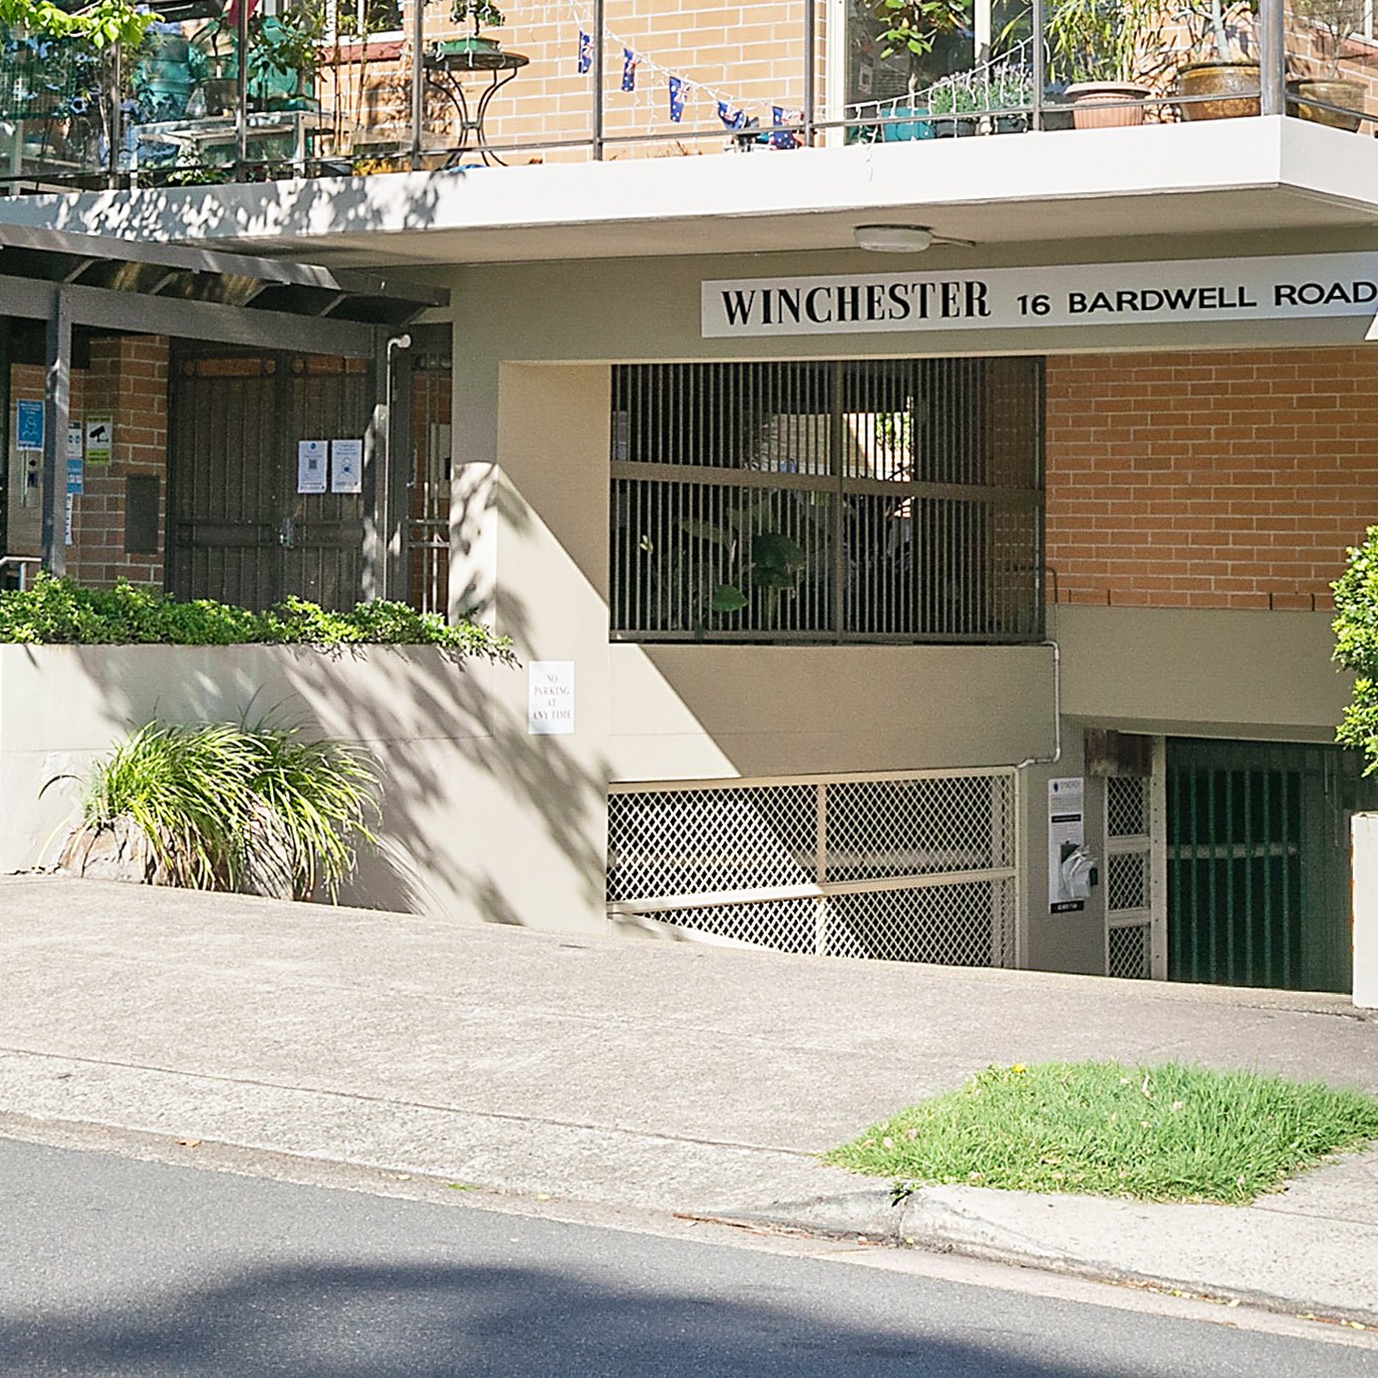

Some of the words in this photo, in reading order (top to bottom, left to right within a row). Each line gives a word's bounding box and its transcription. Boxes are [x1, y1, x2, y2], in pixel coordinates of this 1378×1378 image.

[722, 280, 991, 325] WINCHESTER
[1017, 293, 1051, 316] 16
[1068, 285, 1257, 314] BARDWELL
[1273, 280, 1378, 306] ROAD
[534, 686, 571, 695] PARKING
